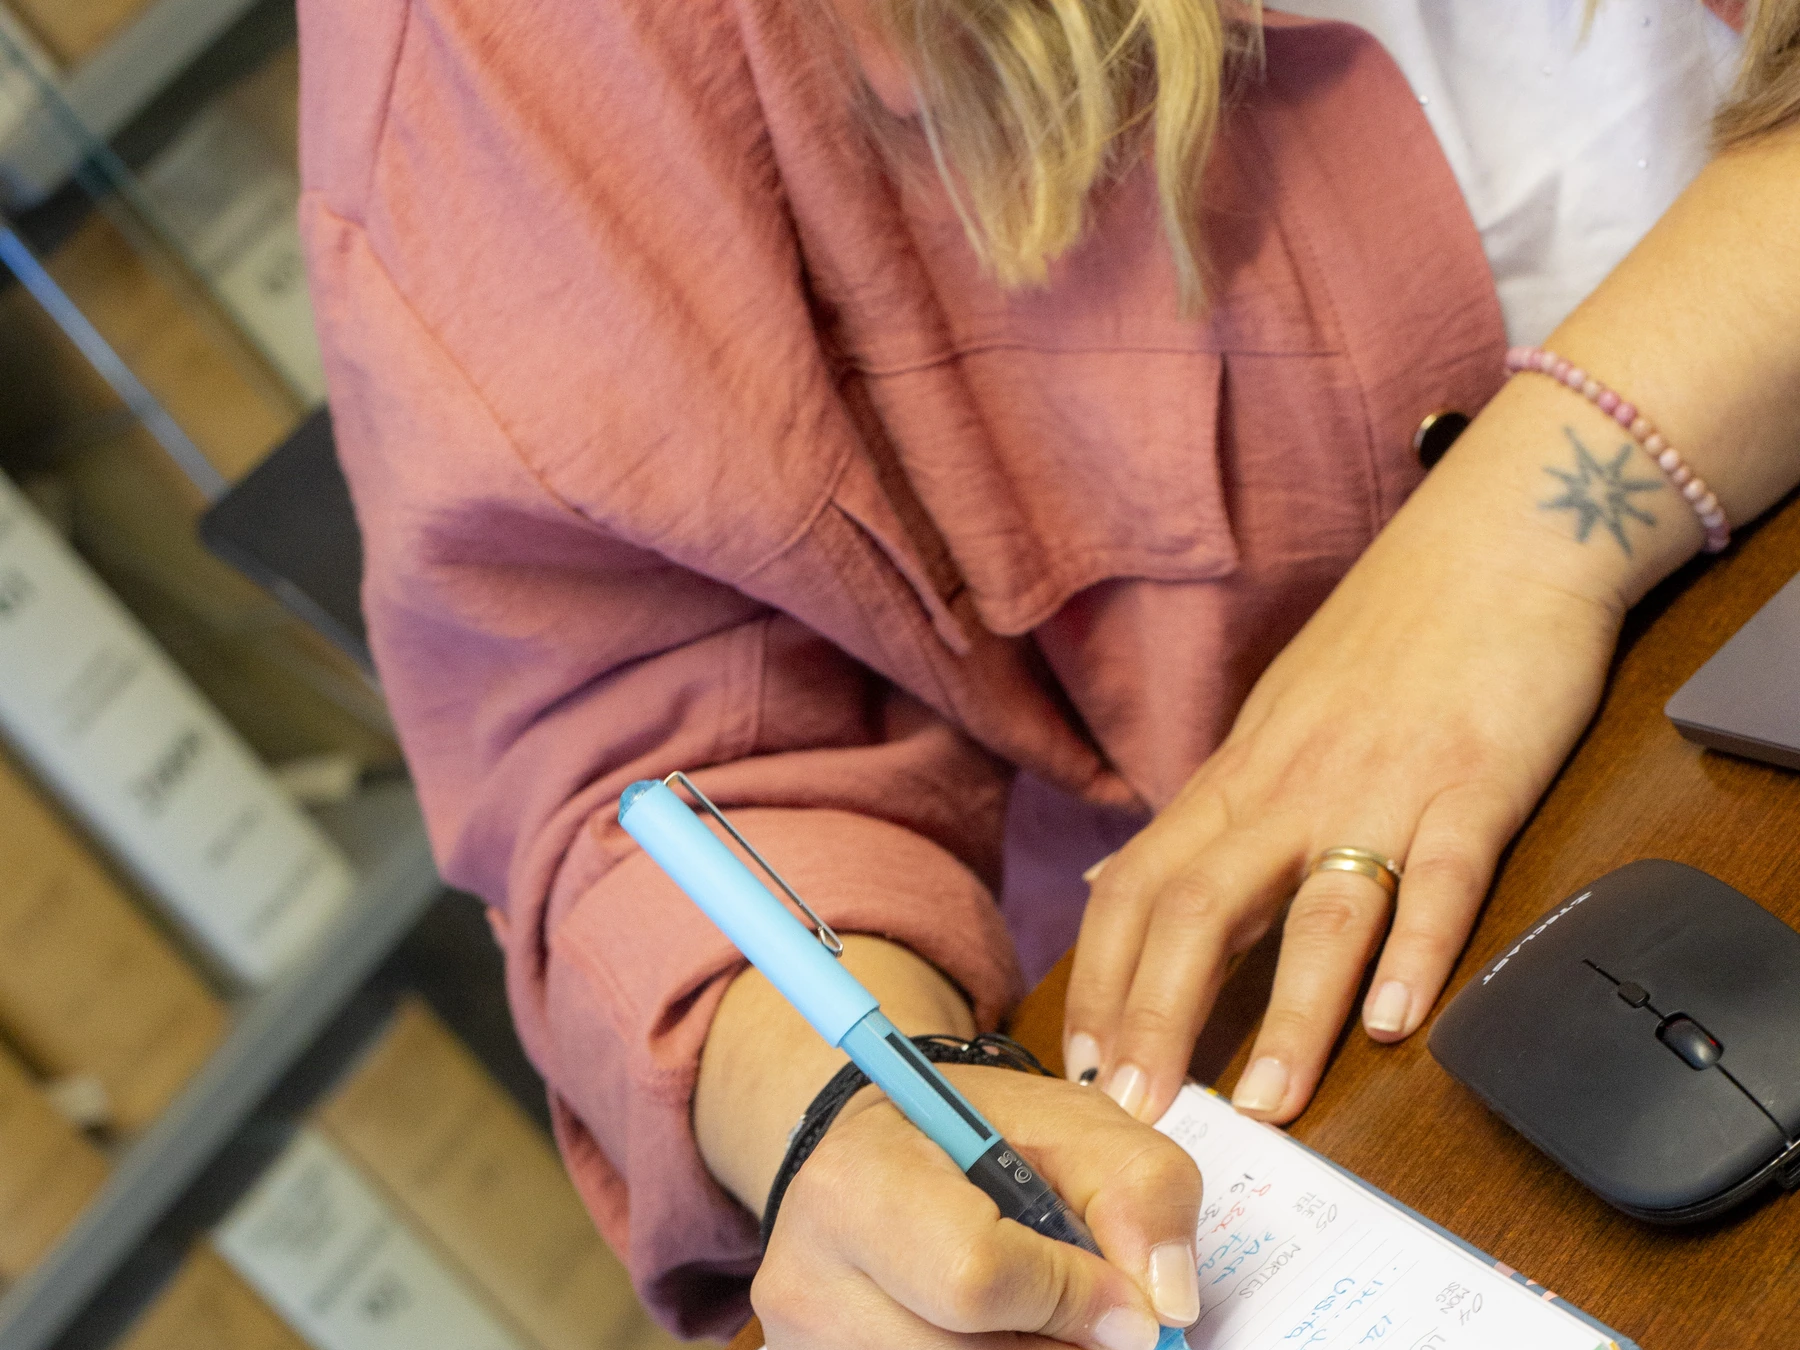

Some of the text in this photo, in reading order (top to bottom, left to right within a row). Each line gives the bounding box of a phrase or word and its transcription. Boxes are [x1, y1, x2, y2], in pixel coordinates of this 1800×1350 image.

[1482, 905, 1574, 986] TECLAST
[1292, 1191, 1317, 1213] TER
[1301, 1199, 1327, 1219] TUE
[1315, 1203, 1338, 1233] 05
[1232, 1243, 1302, 1301] MARTES
[1435, 1281, 1461, 1303] SEG
[1439, 1287, 1471, 1315] MON
[1459, 1292, 1483, 1326] 04
